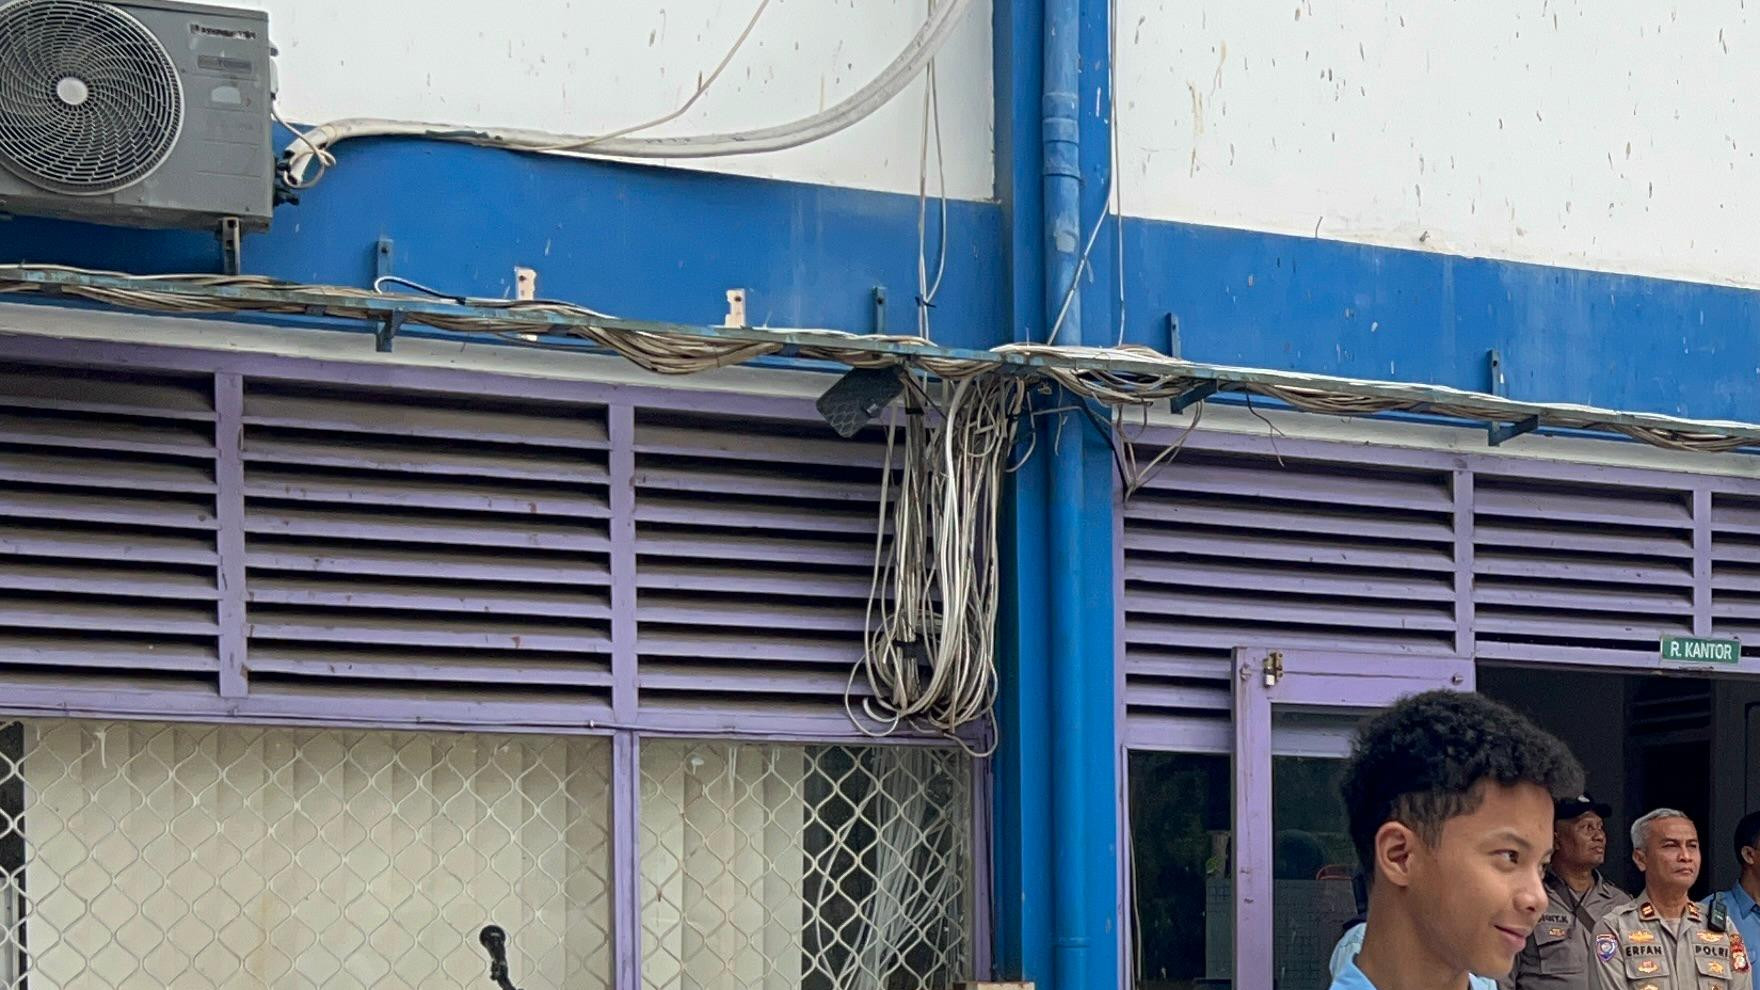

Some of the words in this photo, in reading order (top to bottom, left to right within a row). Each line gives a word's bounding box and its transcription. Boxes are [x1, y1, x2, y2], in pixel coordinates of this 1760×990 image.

[1670, 640, 1682, 657] R.
[1684, 641, 1732, 660] KANTOR
[1625, 945, 1662, 957] ERFAN
[1695, 945, 1729, 958] POLRI
